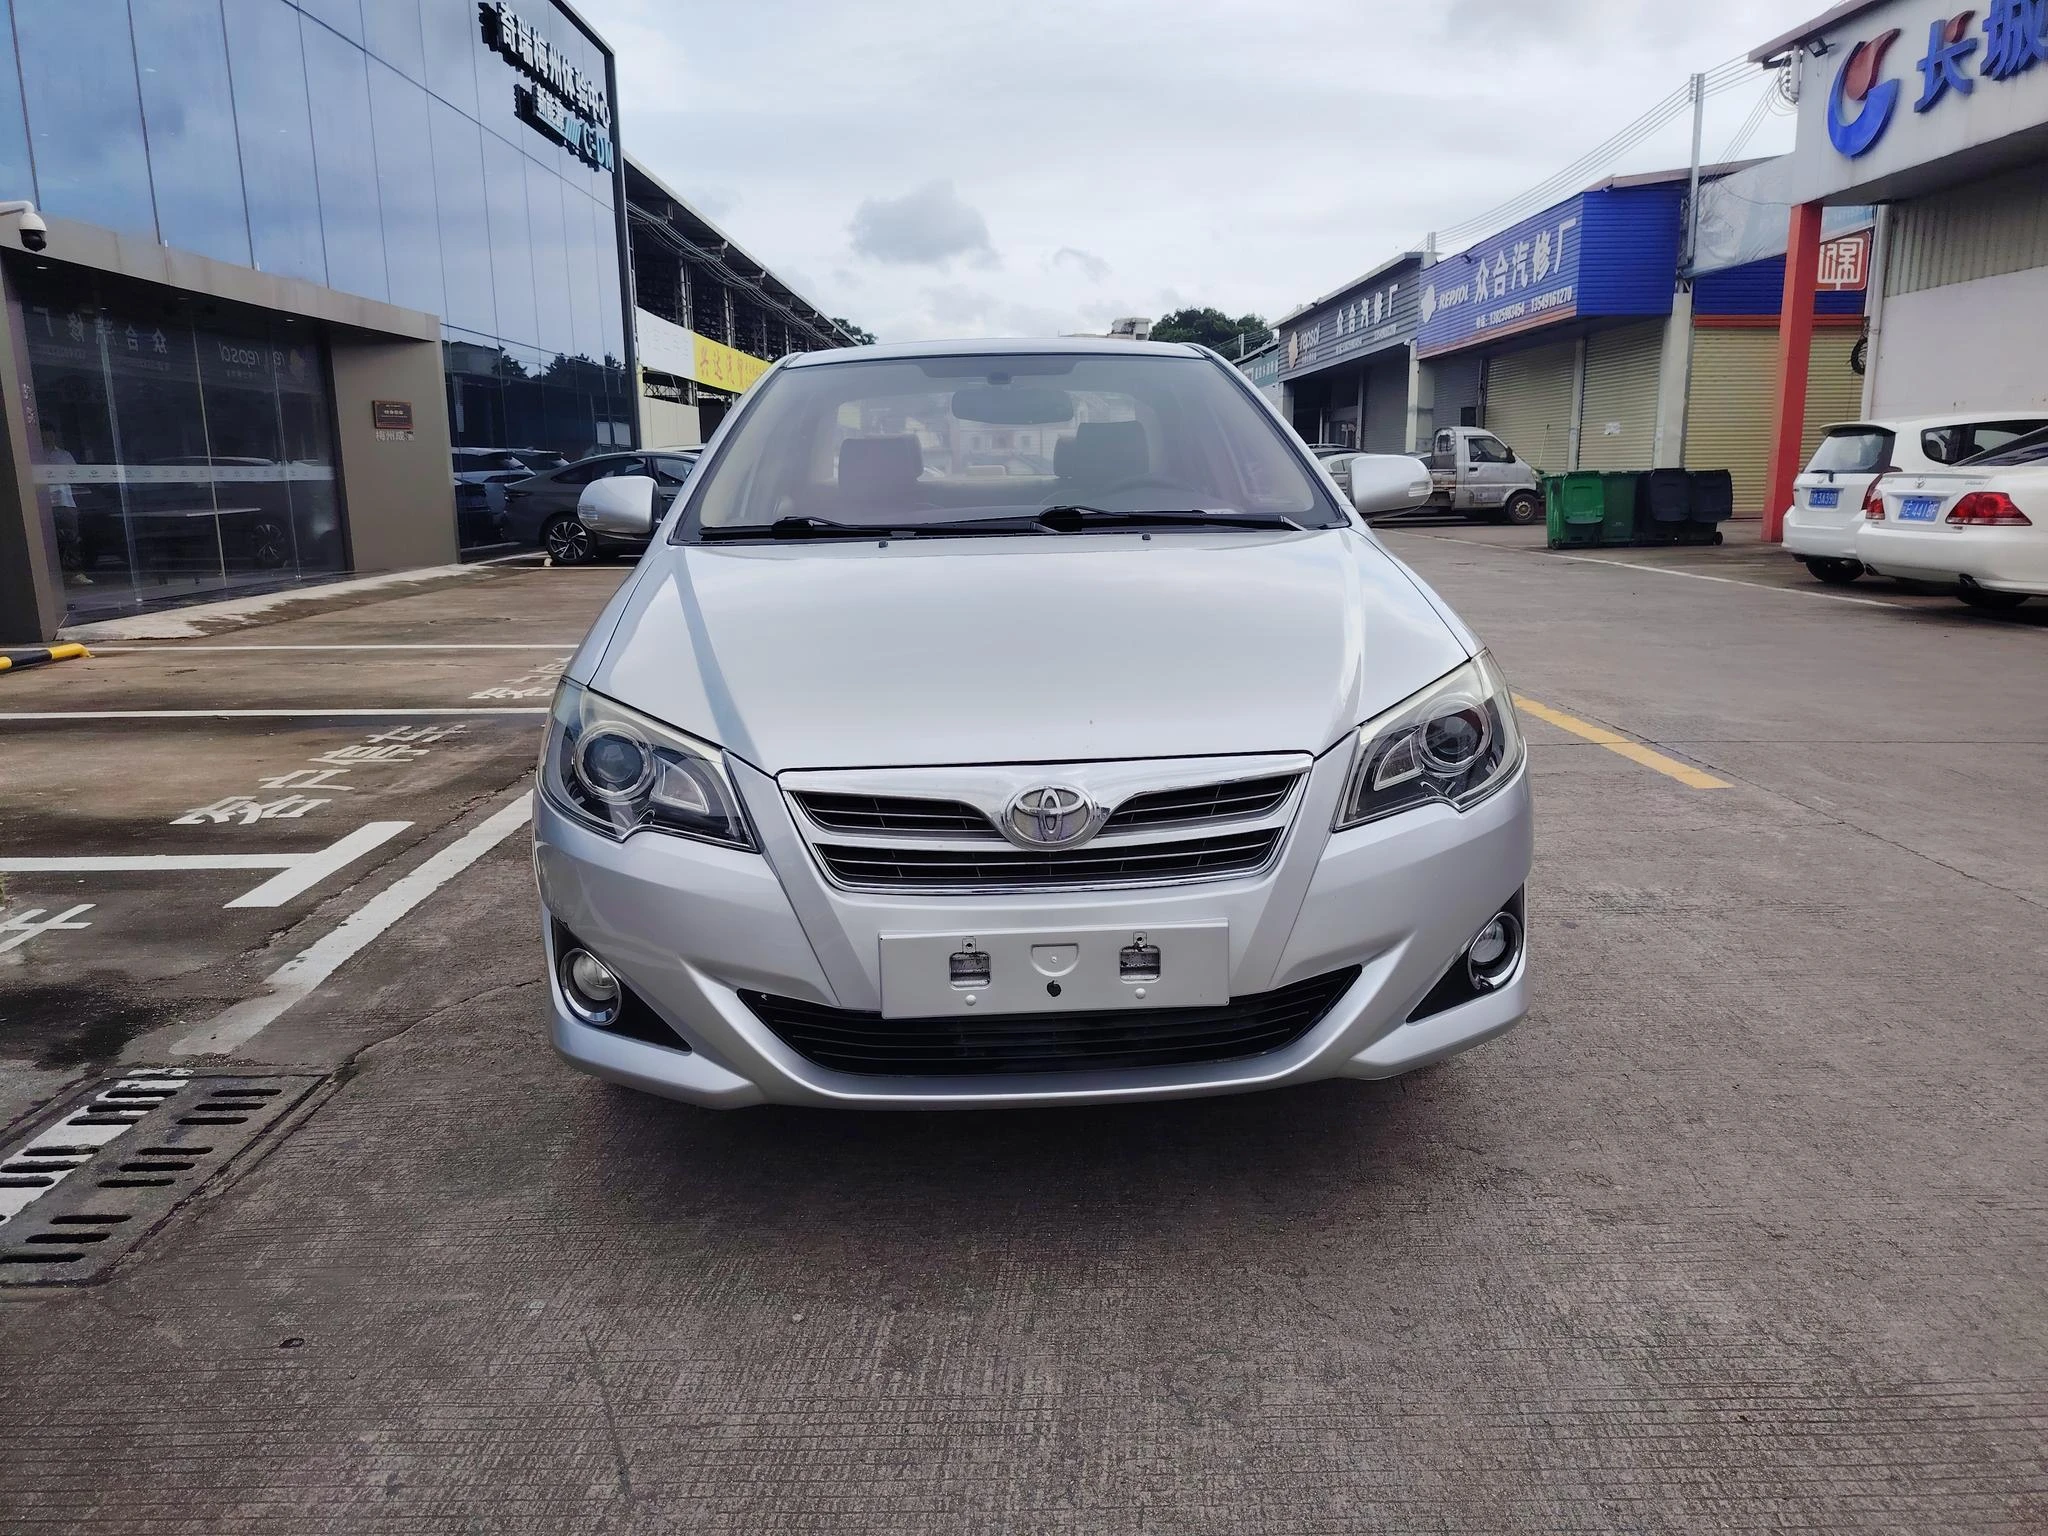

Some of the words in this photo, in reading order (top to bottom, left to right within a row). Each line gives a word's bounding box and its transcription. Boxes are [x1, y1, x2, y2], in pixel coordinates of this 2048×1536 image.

[500, 2, 611, 129] 奇瑞梅州体验中心
[1336, 283, 1399, 338] 众合汽修厂
[1438, 284, 1469, 311] REPSOL
[1473, 217, 1577, 304] 众合汽修厂
[1300, 322, 1320, 353] repsol
[169, 724, 471, 826] 客户停车
